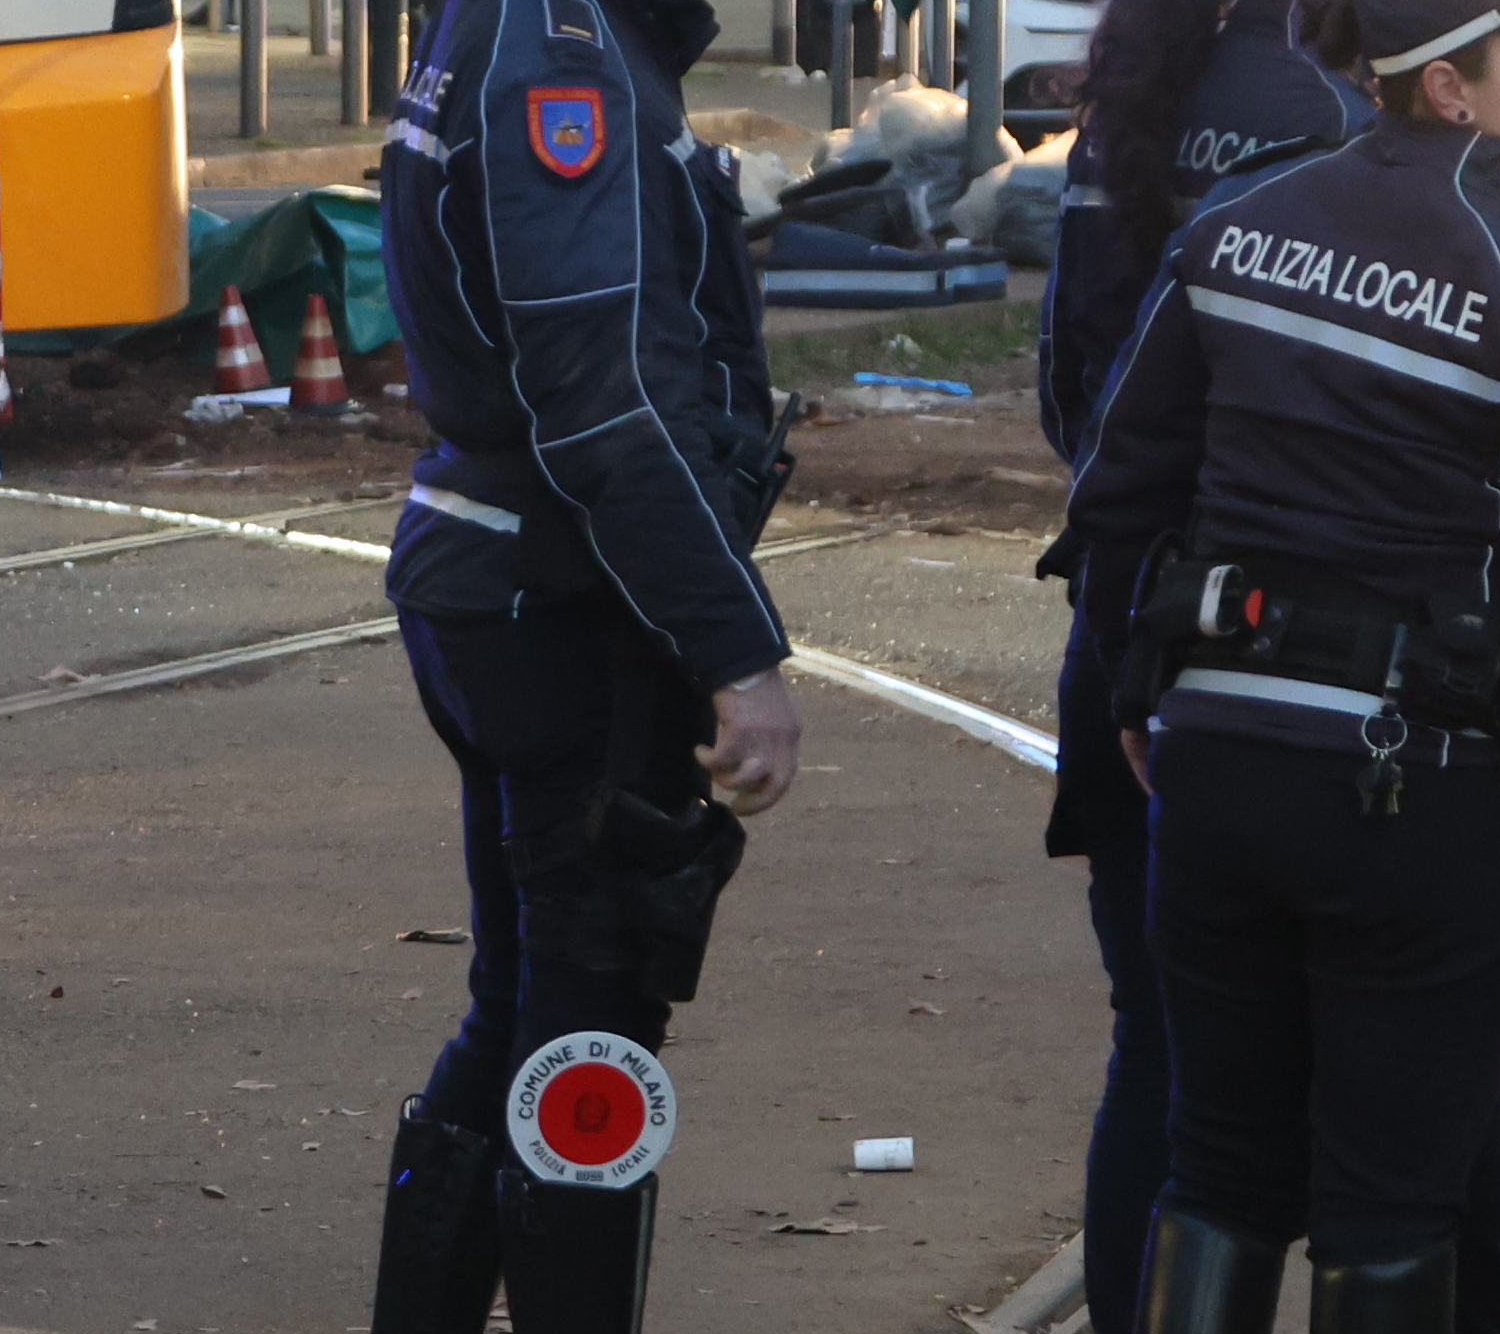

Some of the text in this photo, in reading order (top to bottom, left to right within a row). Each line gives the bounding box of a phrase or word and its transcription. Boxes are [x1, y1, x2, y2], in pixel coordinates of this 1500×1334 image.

[1210, 224, 1490, 344] POLIZIA LOCALE
[518, 1041, 667, 1127] COMUNE DI MILANO
